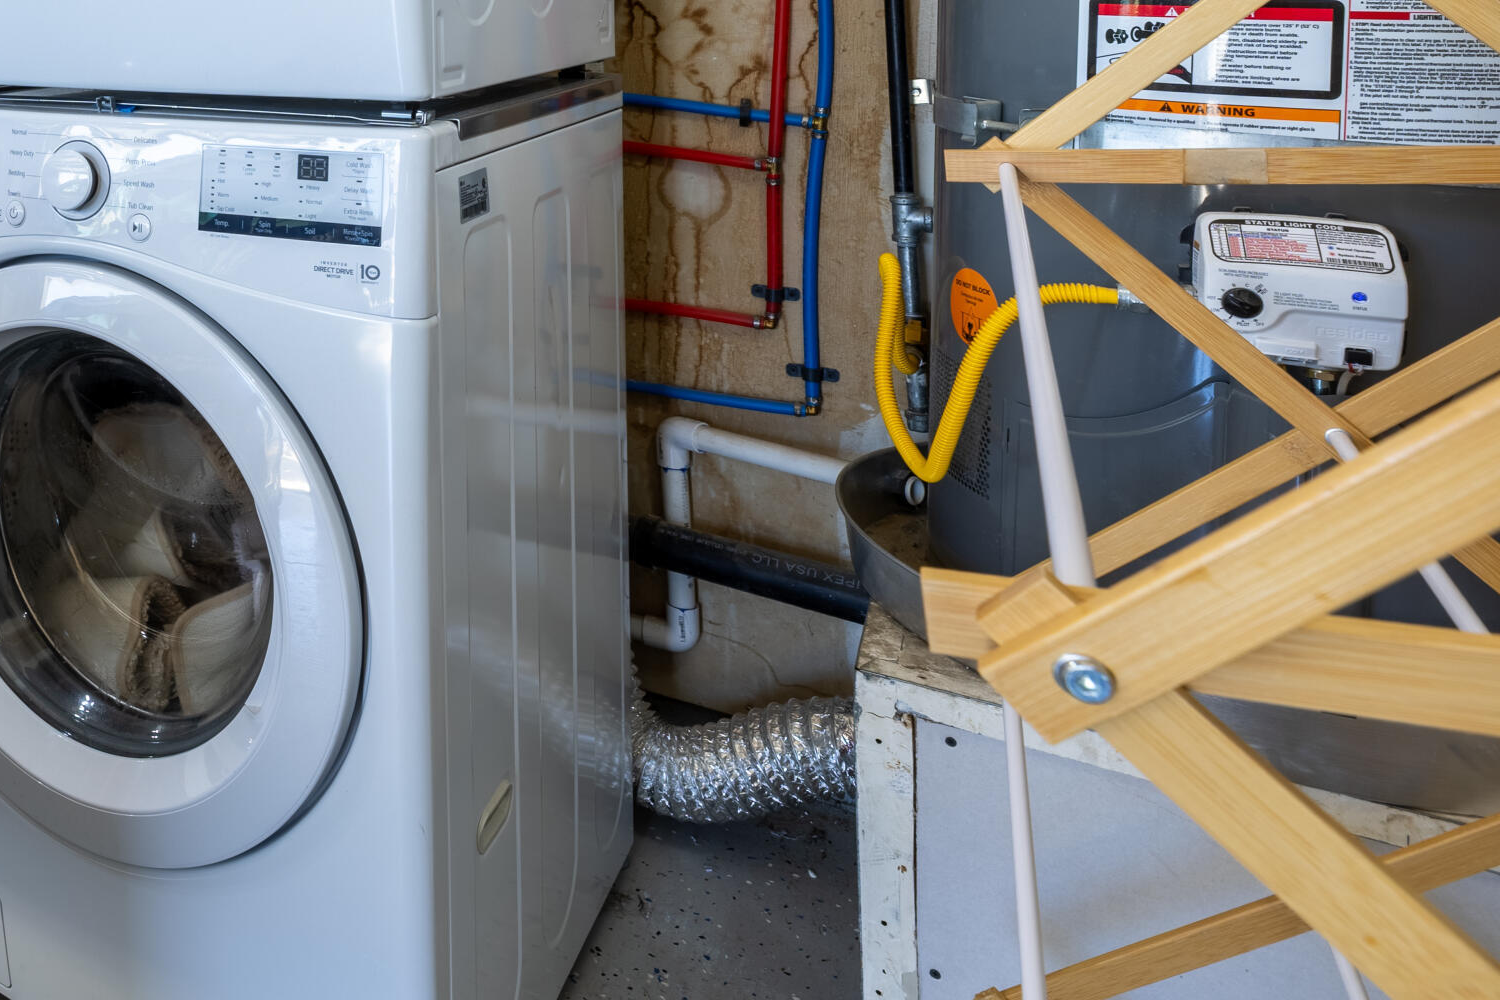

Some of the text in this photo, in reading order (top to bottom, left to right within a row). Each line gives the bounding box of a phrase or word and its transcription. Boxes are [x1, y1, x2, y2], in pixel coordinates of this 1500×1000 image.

[1181, 104, 1256, 117] WARNING
[133, 136, 158, 145] Delicates
[138, 180, 155, 189] Wash
[138, 203, 154, 211] Clean
[214, 219, 229, 227] Temp.
[258, 221, 271, 229] Spin
[1316, 223, 1344, 231] CODE
[335, 267, 354, 276] DRIVE
[972, 284, 991, 296] BLOCK
